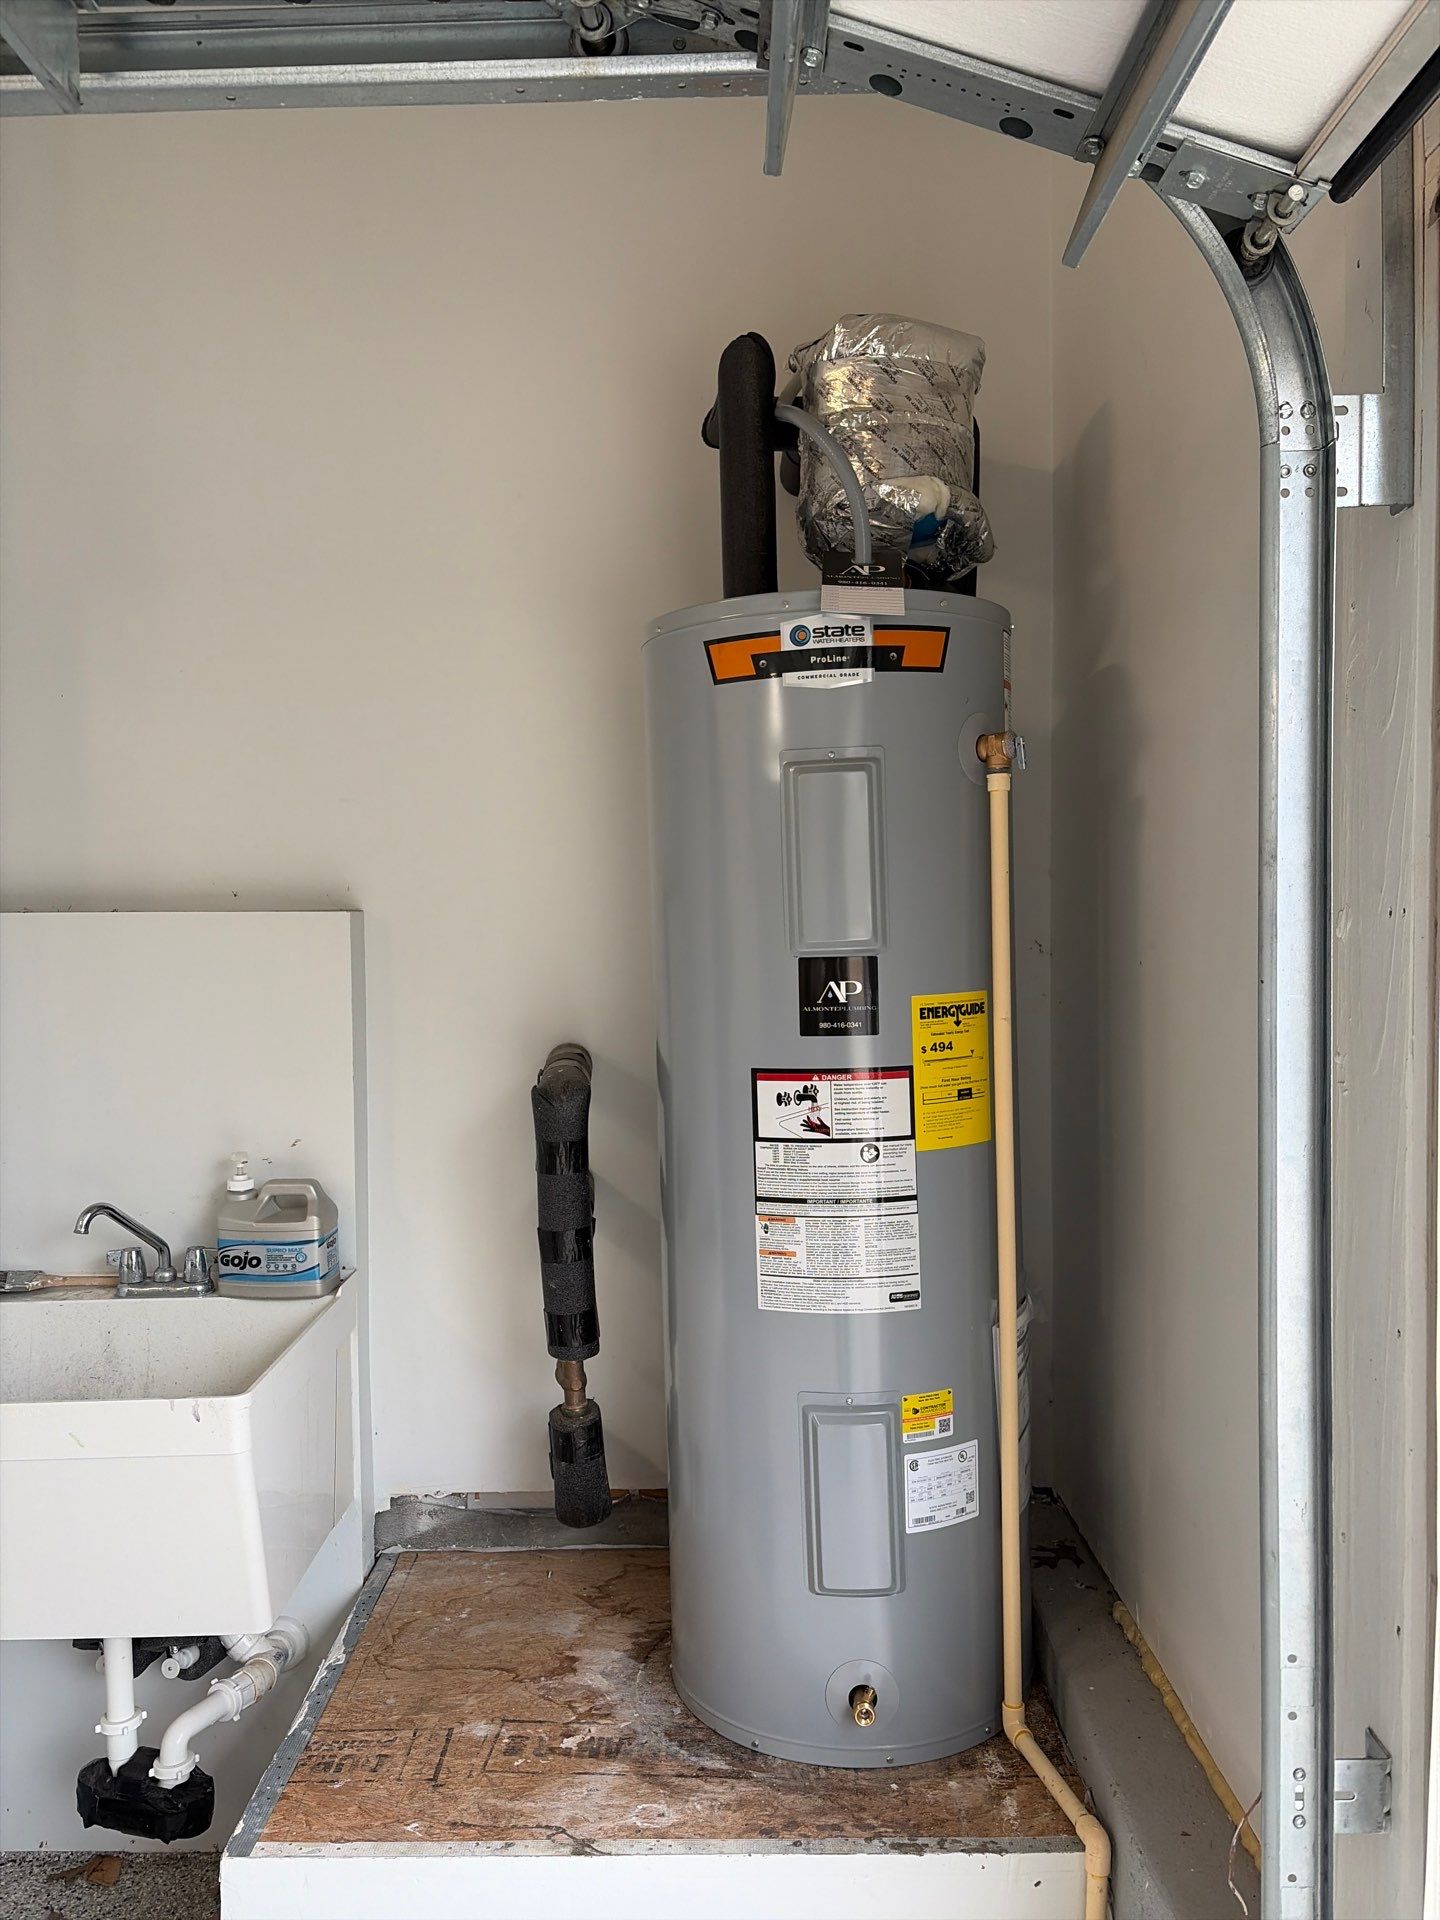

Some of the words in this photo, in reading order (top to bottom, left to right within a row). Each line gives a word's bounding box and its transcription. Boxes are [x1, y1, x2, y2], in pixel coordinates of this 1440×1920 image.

[812, 624, 865, 638] state
[810, 655, 848, 664] ProLine
[816, 980, 863, 1003] AP
[819, 1021, 862, 1029] 980-416-0341
[921, 1045, 927, 1054] $
[930, 1041, 953, 1053] 494
